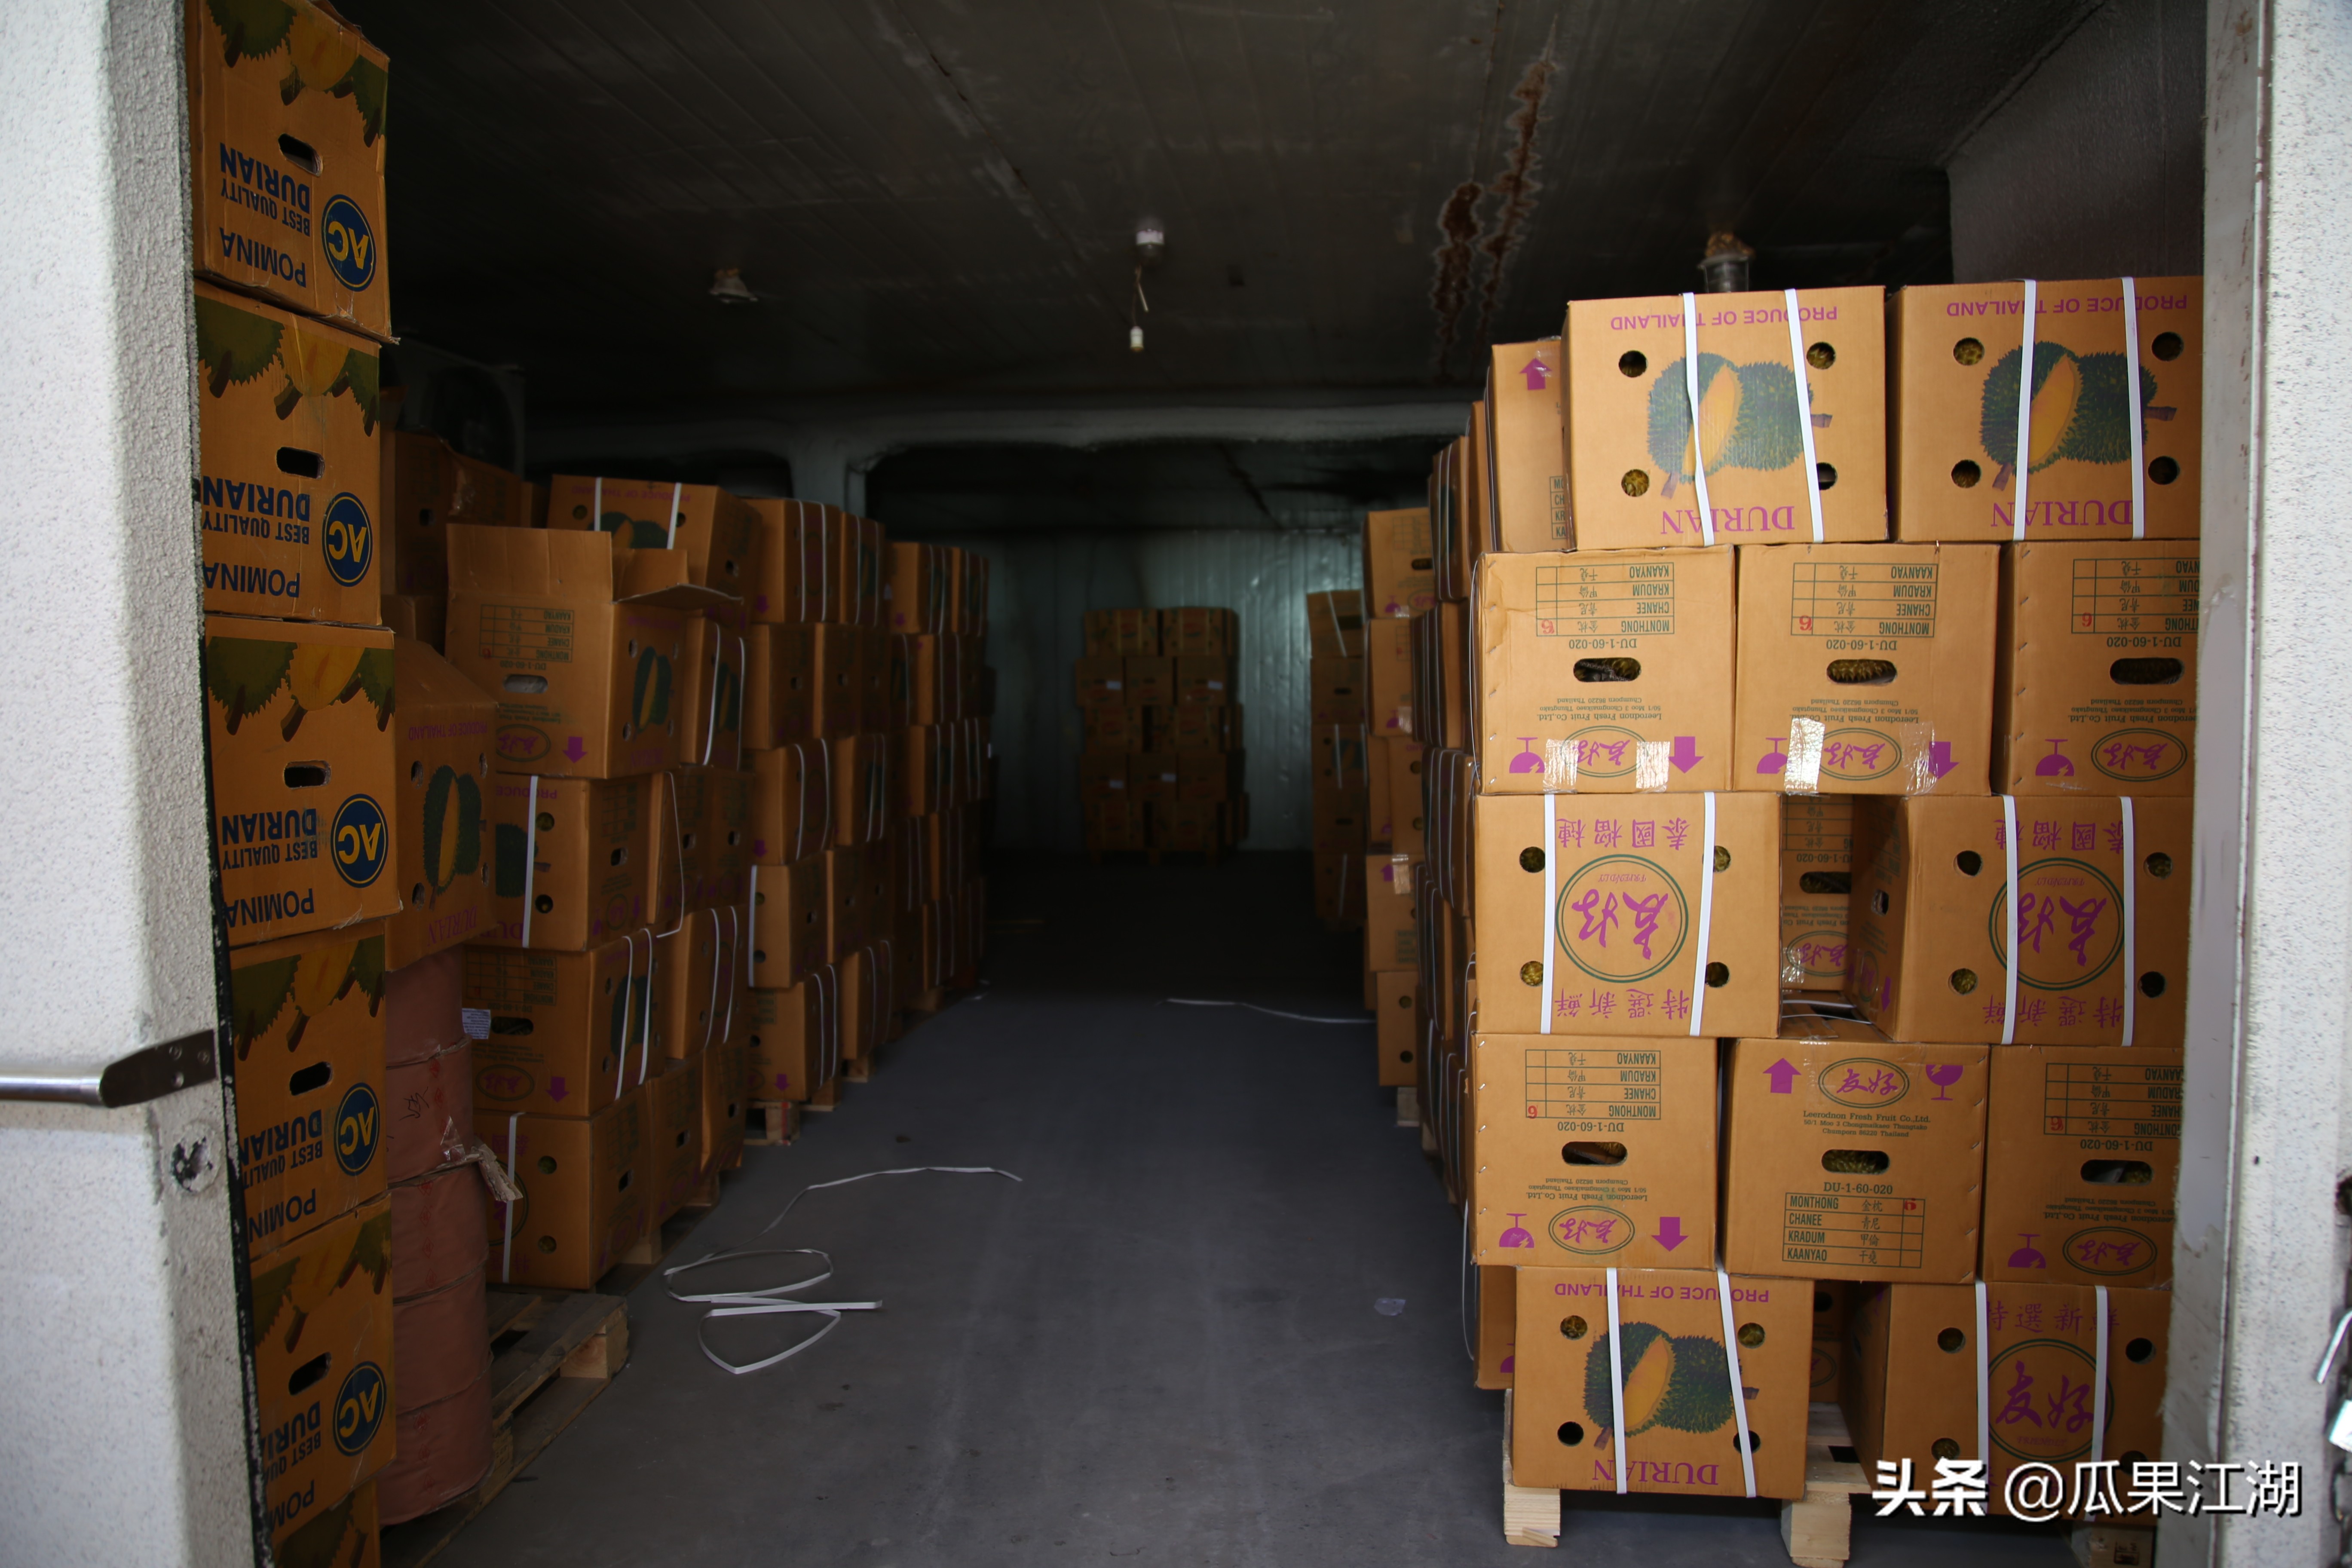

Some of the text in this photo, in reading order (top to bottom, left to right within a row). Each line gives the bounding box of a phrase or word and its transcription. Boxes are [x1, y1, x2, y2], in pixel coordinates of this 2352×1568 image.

[220, 143, 310, 214] DURIAN
[221, 178, 310, 237] BEST QUALITY
[219, 227, 306, 288] POMINA
[328, 221, 369, 270] AC
[1946, 300, 2047, 316] TAILAND
[2053, 298, 2080, 313] OF
[1611, 313, 1706, 330] TAILAND
[1712, 311, 1737, 326] OF
[203, 476, 310, 522] DURIAN
[1660, 505, 1795, 534] DURIAN
[1991, 500, 2132, 527] DURIAN
[202, 511, 310, 544] BEST QUALITY
[328, 521, 367, 563] AC
[202, 561, 300, 597] POMINA
[1629, 565, 1669, 578] KAANYAO
[1891, 566, 1932, 579] KAANYAO
[1633, 584, 1669, 596] KRADUM
[1894, 585, 1931, 597] KRADUM
[1637, 602, 1669, 614] CHANEE
[1896, 603, 1930, 616] CHANEE
[1621, 620, 1669, 632] MONTHONG
[1879, 622, 1929, 634] MONTHONG
[1569, 638, 1637, 649] DU-1-60-020
[1827, 640, 1897, 650] DU-1-60-020
[2107, 637, 2181, 647] DU-1-60-020
[409, 721, 487, 741] PRODUCE OF THAILAND
[1572, 740, 1630, 766] 友好
[1823, 742, 1885, 769] 友好
[2103, 743, 2168, 770] 友好
[496, 786, 557, 799] PRDUCE
[222, 808, 317, 845] DURIAN
[1556, 818, 1690, 851] 泰國榴槤
[222, 840, 318, 870] BEST QUALITY
[338, 823, 381, 864] AC
[1598, 873, 1646, 882] FRIENDLY
[225, 888, 315, 928] POMINA
[428, 905, 477, 946] DURIAN
[1571, 889, 1668, 960] 友好
[2017, 892, 2107, 966] 友好
[1555, 989, 1690, 1020] 特選新鮮
[1983, 995, 2123, 1029] 特選新鮮
[1617, 1053, 1656, 1064] KAANYAO
[1620, 1070, 1656, 1082] KRADUM
[1836, 1069, 1898, 1096] 友好
[1624, 1088, 1656, 1099] CHANEE
[1609, 1105, 1656, 1117] MONTHONG
[240, 1109, 322, 1166] DURIAN
[340, 1106, 374, 1156] AC
[1558, 1122, 1624, 1132] DU-1-60-020
[291, 1140, 323, 1169] BEST
[2080, 1139, 2153, 1152] DU-1-60-020
[1824, 1182, 1893, 1194] DU-1-60-020
[1790, 1195, 1838, 1209] MONTHONG
[1559, 1218, 1617, 1243] 友好
[1789, 1213, 1822, 1226] CHANEE
[1788, 1231, 1825, 1243] KRADUM
[1787, 1248, 1827, 1262] KAANYAO
[2076, 1240, 2141, 1266] 友好
[1649, 1286, 1674, 1299] OF
[1680, 1286, 1769, 1302] PROUCE
[1996, 1360, 2094, 1433] 友好
[339, 1381, 379, 1438] AC
[291, 1430, 321, 1467] BEST
